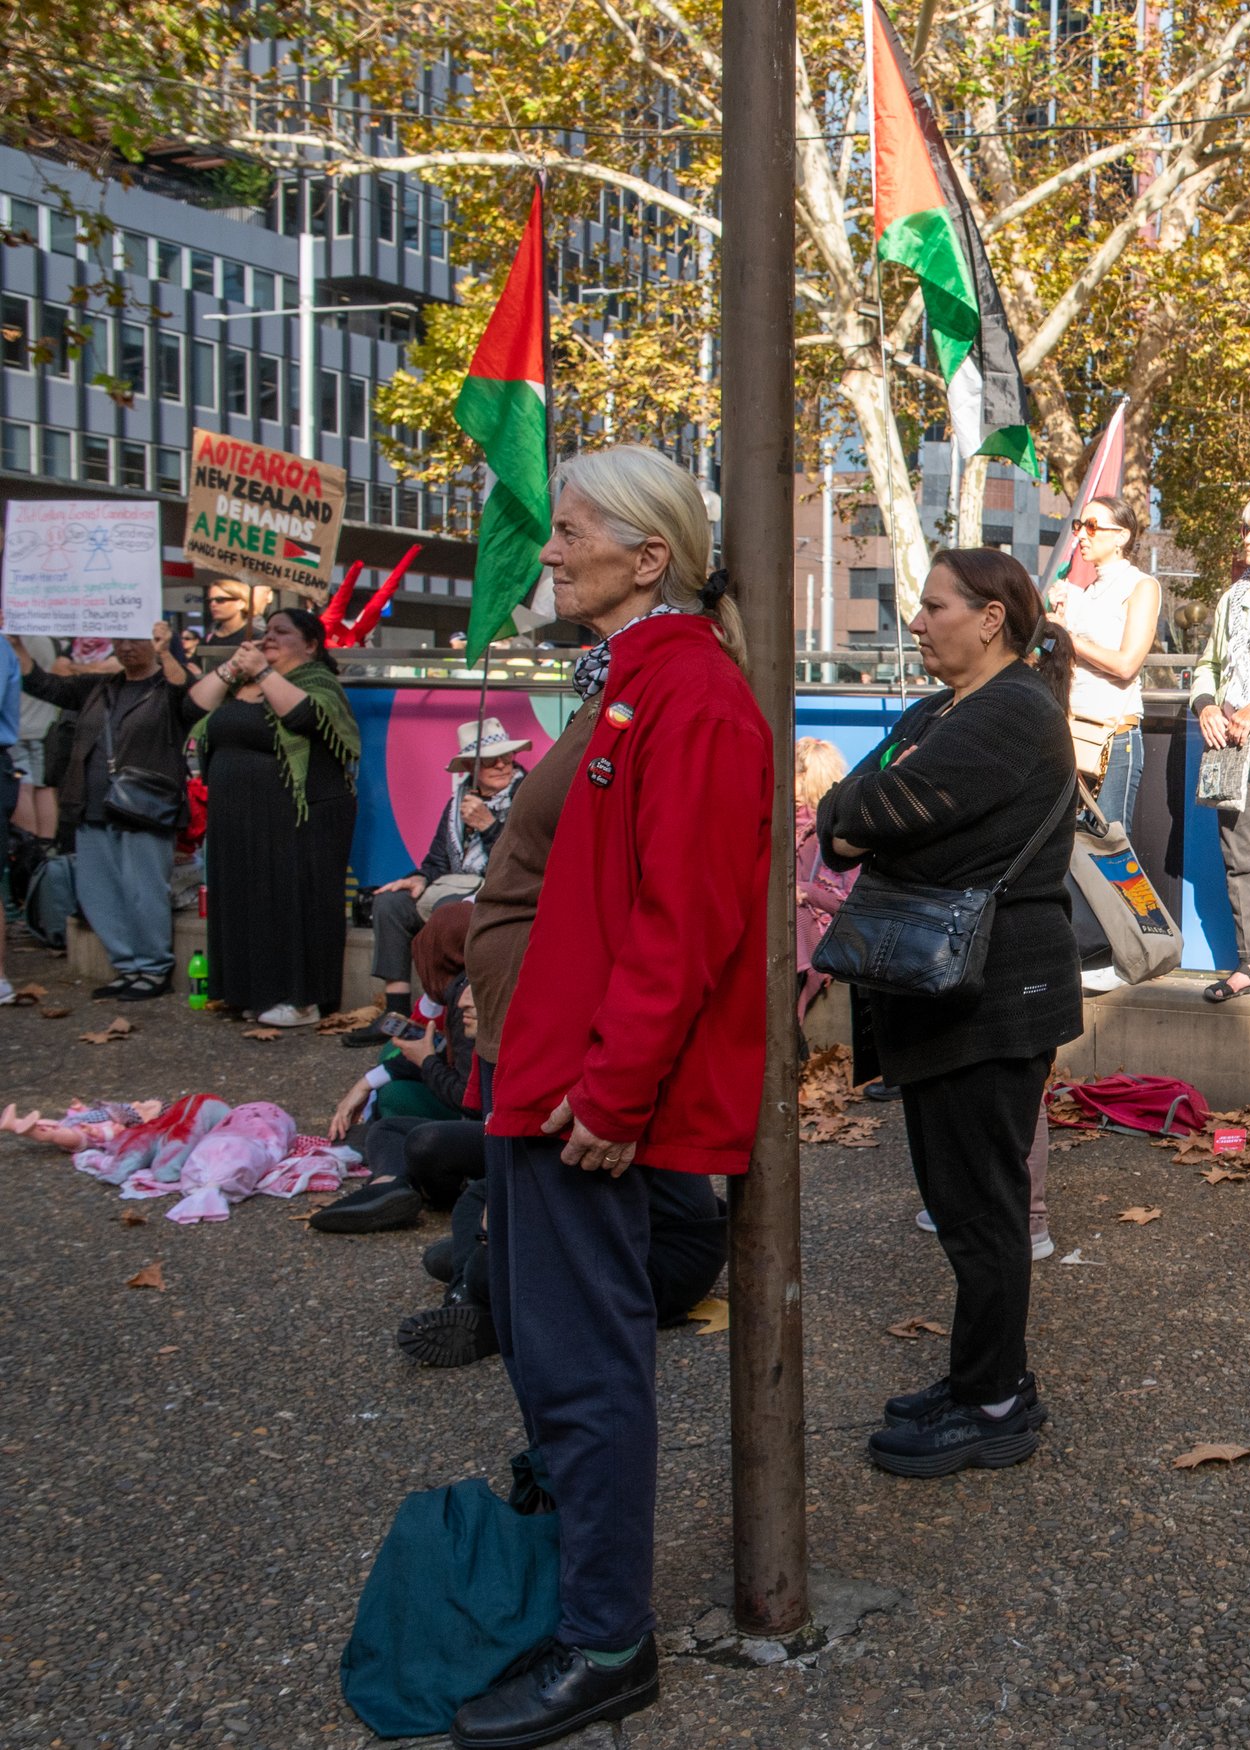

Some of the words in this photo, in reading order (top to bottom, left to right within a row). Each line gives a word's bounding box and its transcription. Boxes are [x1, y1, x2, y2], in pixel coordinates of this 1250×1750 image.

[198, 435, 322, 498] AOTEAROA
[195, 466, 231, 493] NEW
[232, 475, 332, 524] ZEALAND
[193, 511, 210, 538] A
[213, 515, 277, 557] FREE
[215, 494, 316, 542] DEMANDS
[188, 539, 216, 558] HANDS
[217, 548, 238, 566] OFF
[240, 553, 282, 579] YEMEN
[82, 608, 119, 622] Chewing
[108, 595, 142, 609] Licking
[934, 1424, 980, 1448] HOKA
